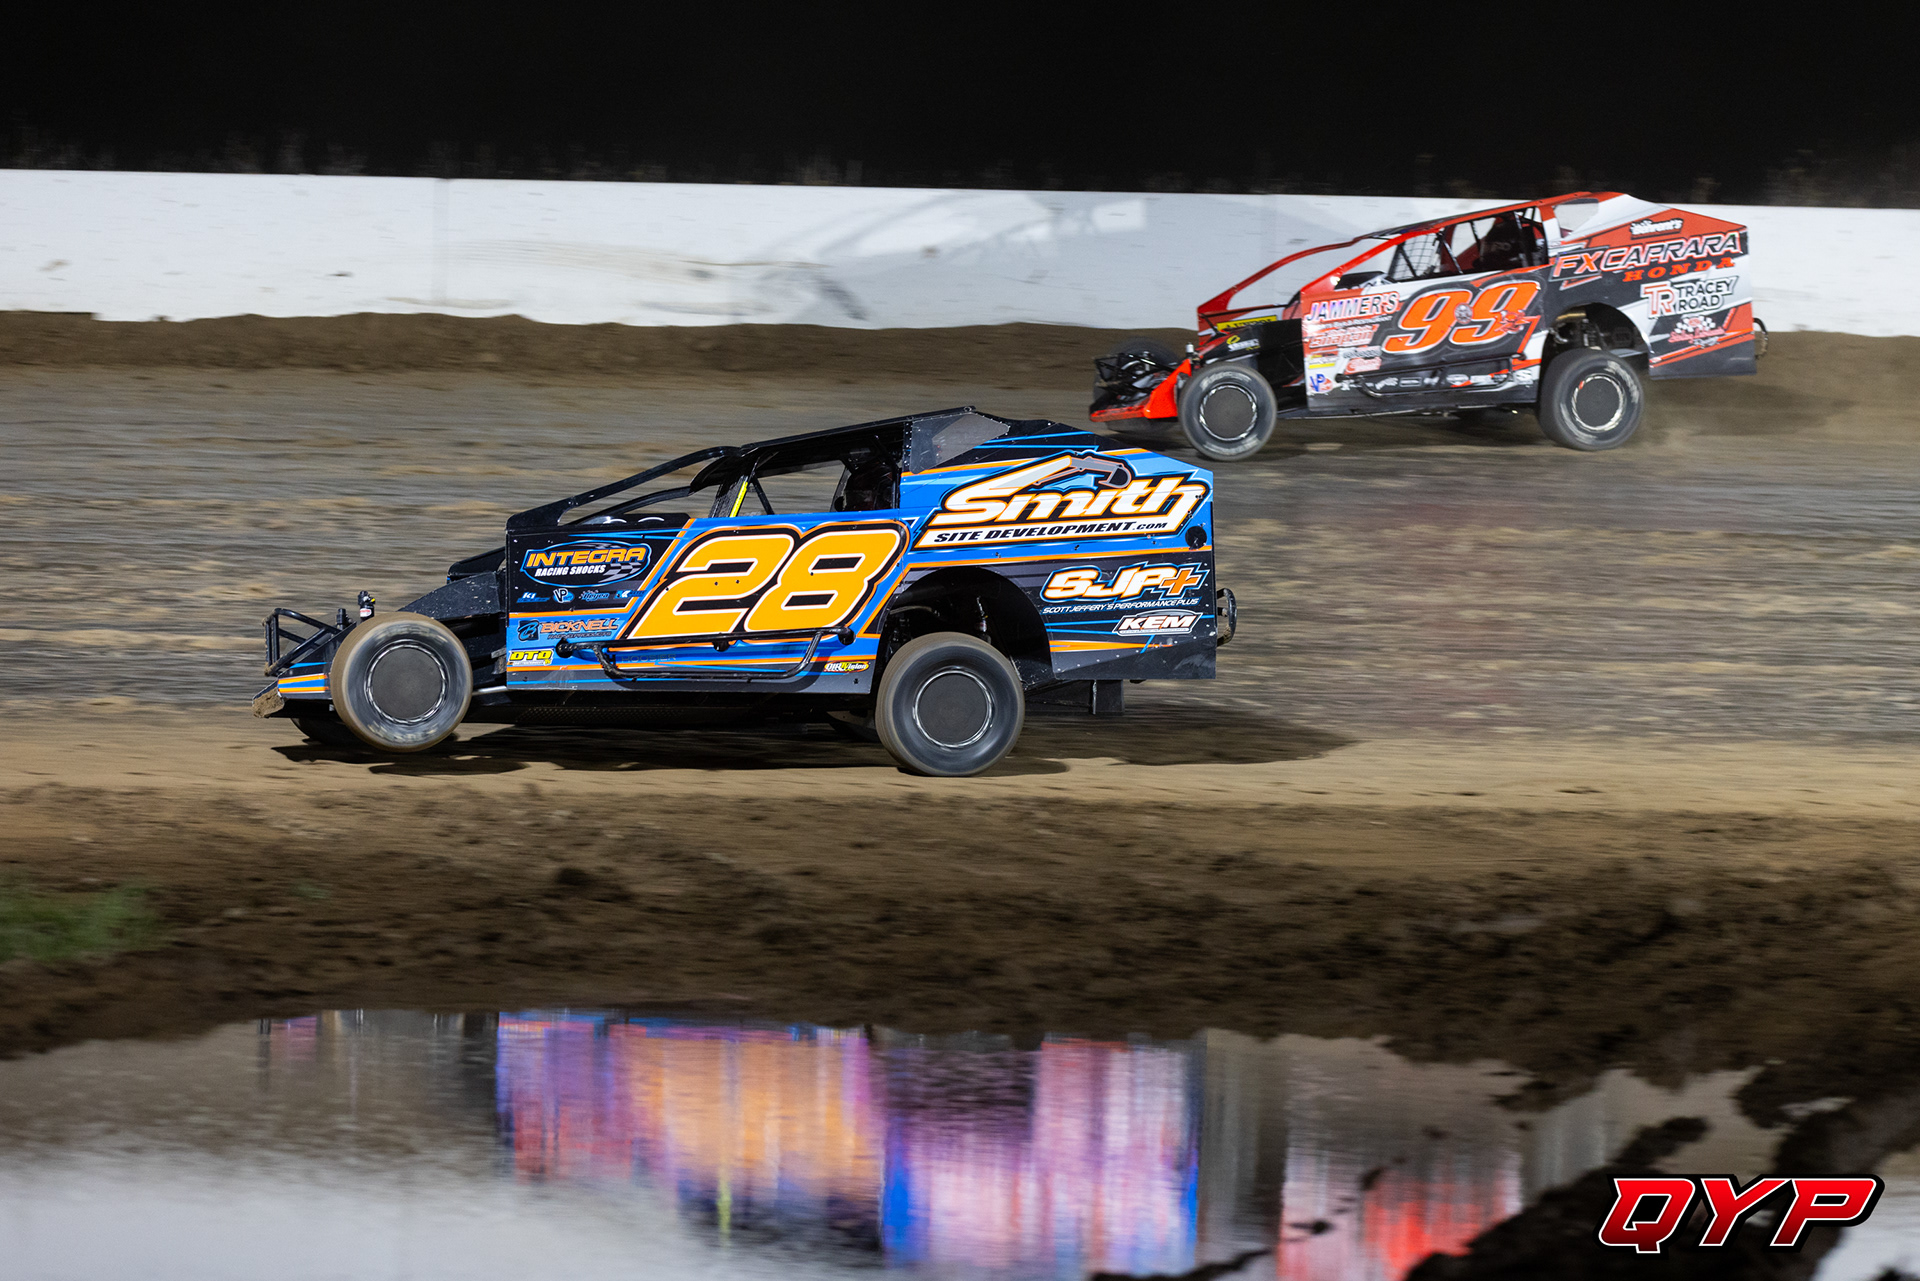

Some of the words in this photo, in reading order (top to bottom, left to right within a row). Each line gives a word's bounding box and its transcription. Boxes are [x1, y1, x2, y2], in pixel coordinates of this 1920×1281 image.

[1552, 250, 1603, 278] FX
[1601, 232, 1743, 270] CAPRARA
[1623, 257, 1735, 282] HONDA
[1675, 278, 1735, 298] TRACEY
[1305, 292, 1399, 321] JAMMER'S
[1679, 295, 1720, 311] ROAD
[1383, 281, 1541, 353] 99
[928, 472, 1207, 526] Smith
[934, 530, 987, 543] SITE
[526, 547, 647, 568] INTEGRA
[535, 566, 569, 577] RACING
[570, 564, 606, 575] SHOCKS
[627, 529, 901, 639] 28
[1042, 606, 1069, 614] SCOTT
[1069, 603, 1115, 612] JEFFERY'S
[1114, 599, 1178, 610] PERFORMANCE
[1177, 598, 1200, 606] PLUS
[541, 617, 620, 634] BICKNELL
[1118, 615, 1197, 630] KEM
[621, 653, 677, 664] HOOSIER
